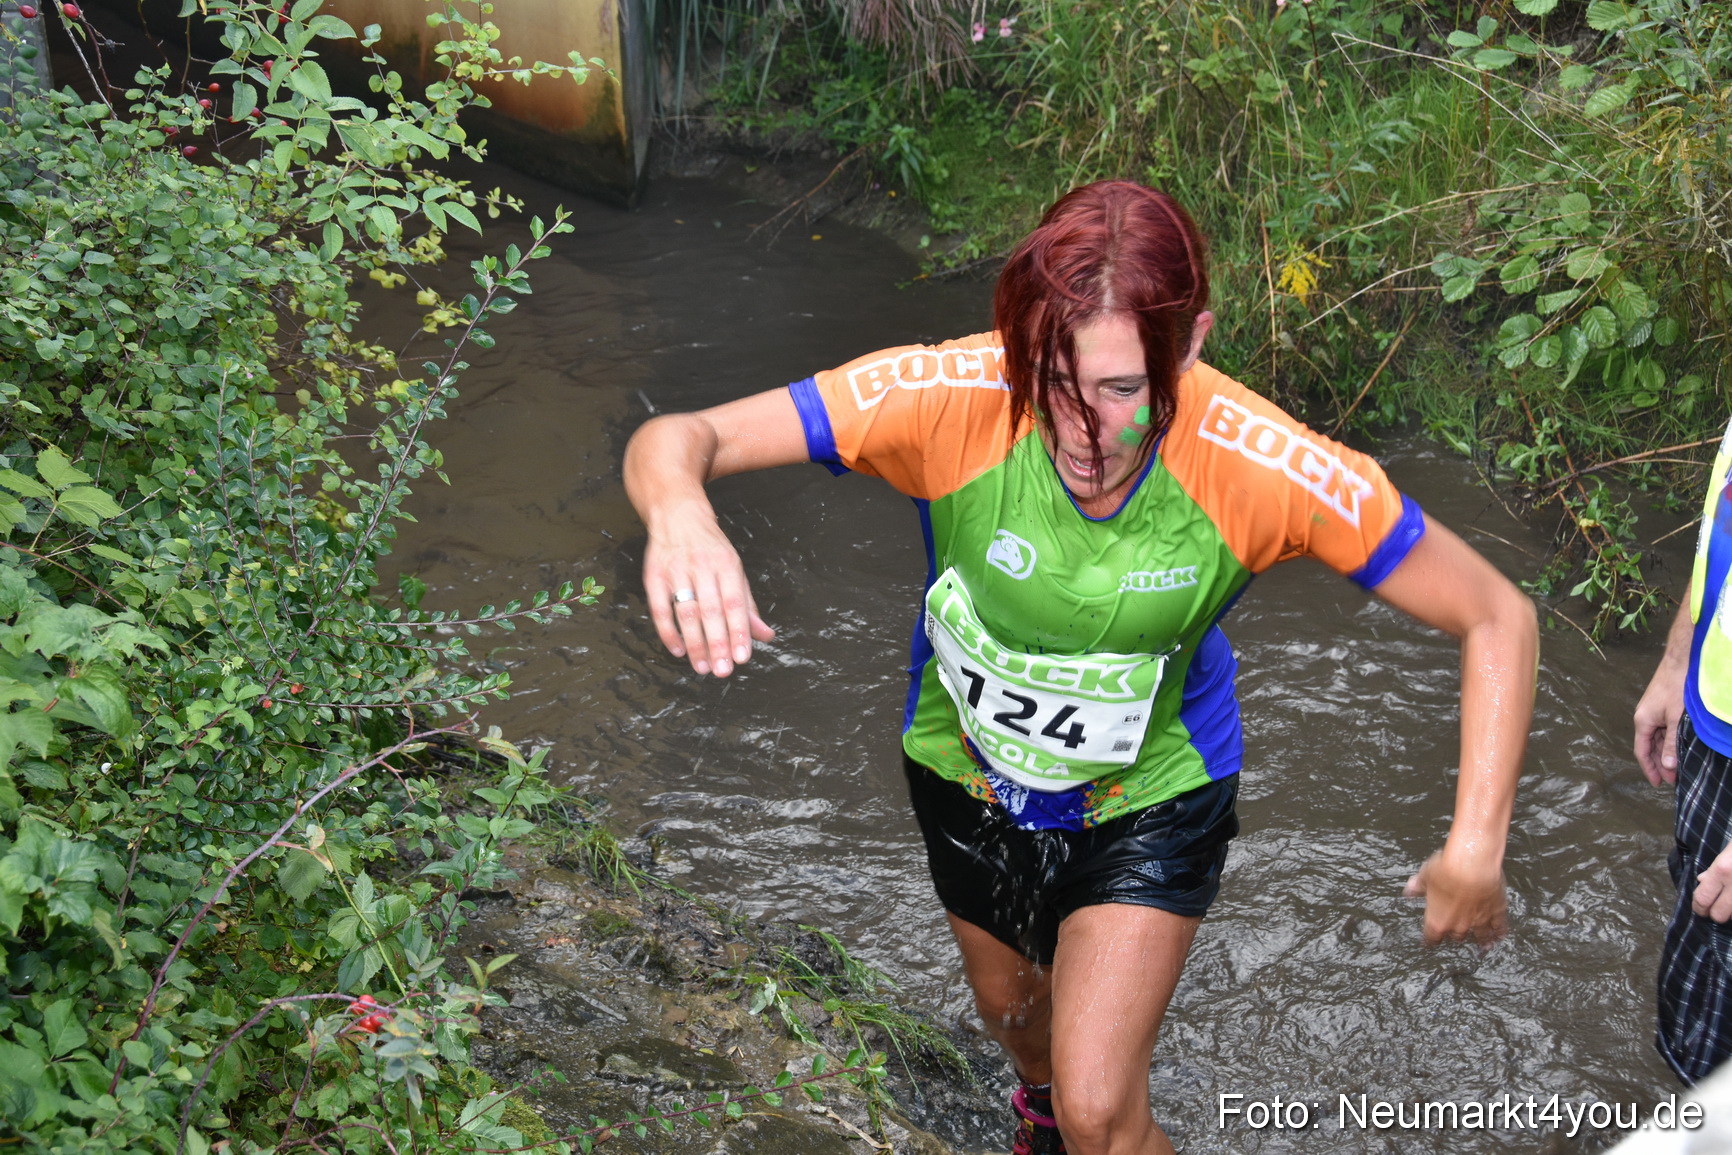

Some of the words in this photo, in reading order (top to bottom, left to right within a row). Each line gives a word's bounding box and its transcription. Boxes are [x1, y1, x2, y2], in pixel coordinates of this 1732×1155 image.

[847, 346, 1012, 411] BOCK
[1197, 394, 1374, 529] BOCK
[940, 591, 1136, 698] BOCK
[960, 665, 1087, 750] 124
[1124, 714, 1141, 723] E6
